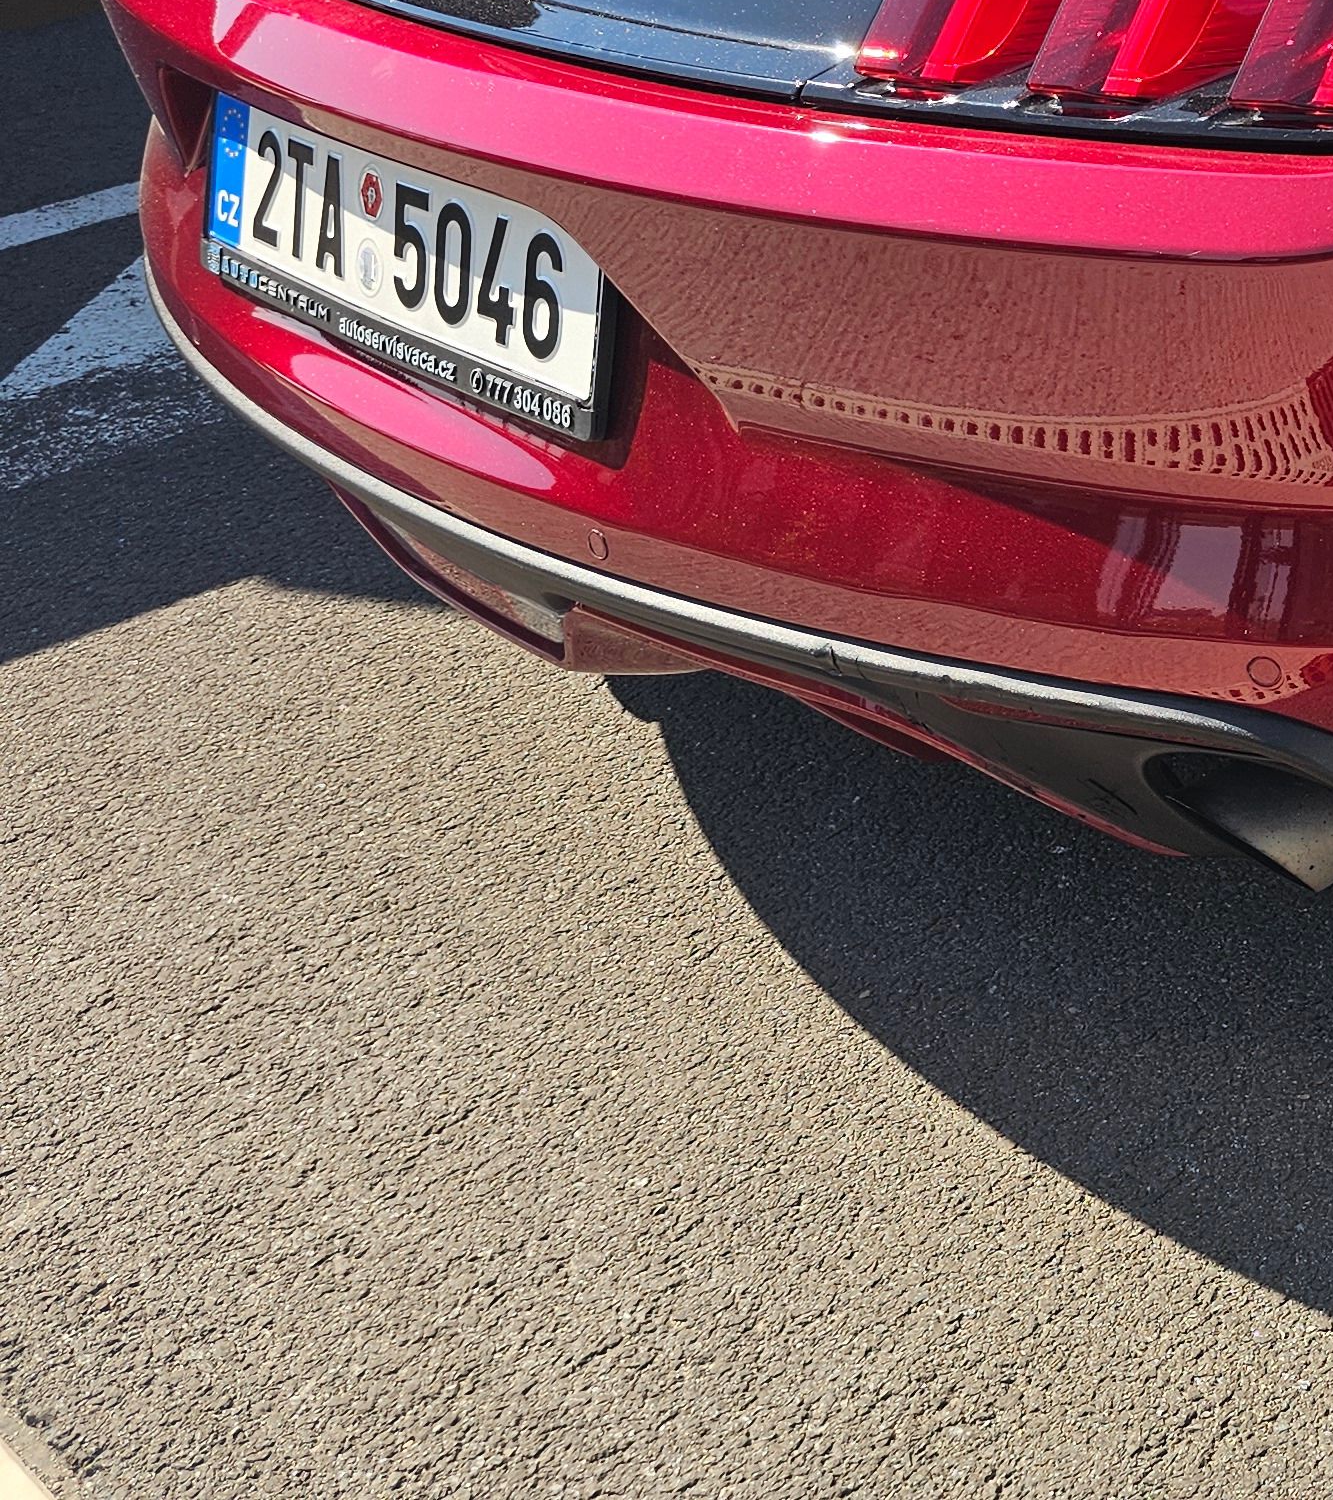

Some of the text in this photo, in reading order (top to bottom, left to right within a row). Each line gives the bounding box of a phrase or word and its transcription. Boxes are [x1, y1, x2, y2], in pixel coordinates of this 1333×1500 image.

[217, 190, 240, 227] CZ
[252, 129, 564, 360] 2TA 5046
[221, 255, 331, 322] AUTOCENTRUM
[338, 315, 457, 382] autoservisvaca.cz
[486, 373, 511, 404] 777
[513, 386, 541, 420] 304
[543, 399, 575, 430] 086
